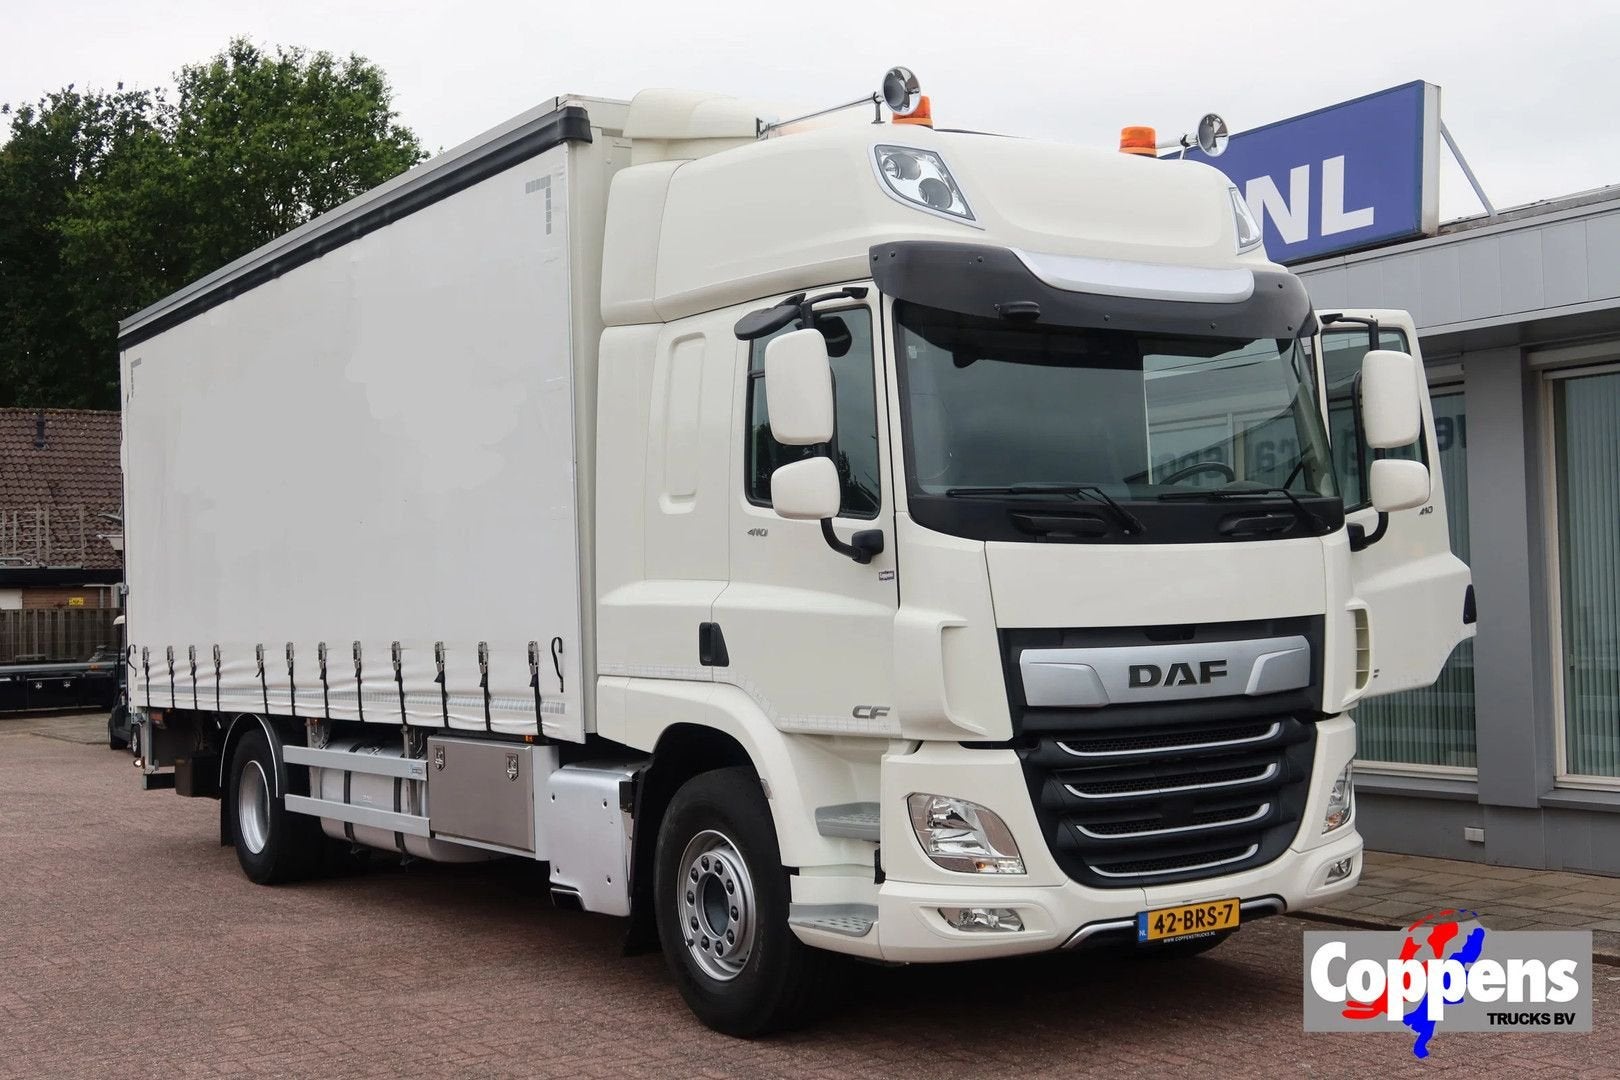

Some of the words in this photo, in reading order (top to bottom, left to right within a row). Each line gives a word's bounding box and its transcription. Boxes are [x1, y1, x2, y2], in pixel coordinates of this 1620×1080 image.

[1129, 660, 1227, 688] DAF
[852, 705, 890, 719] CF
[1154, 904, 1233, 934] 42-BRS-7
